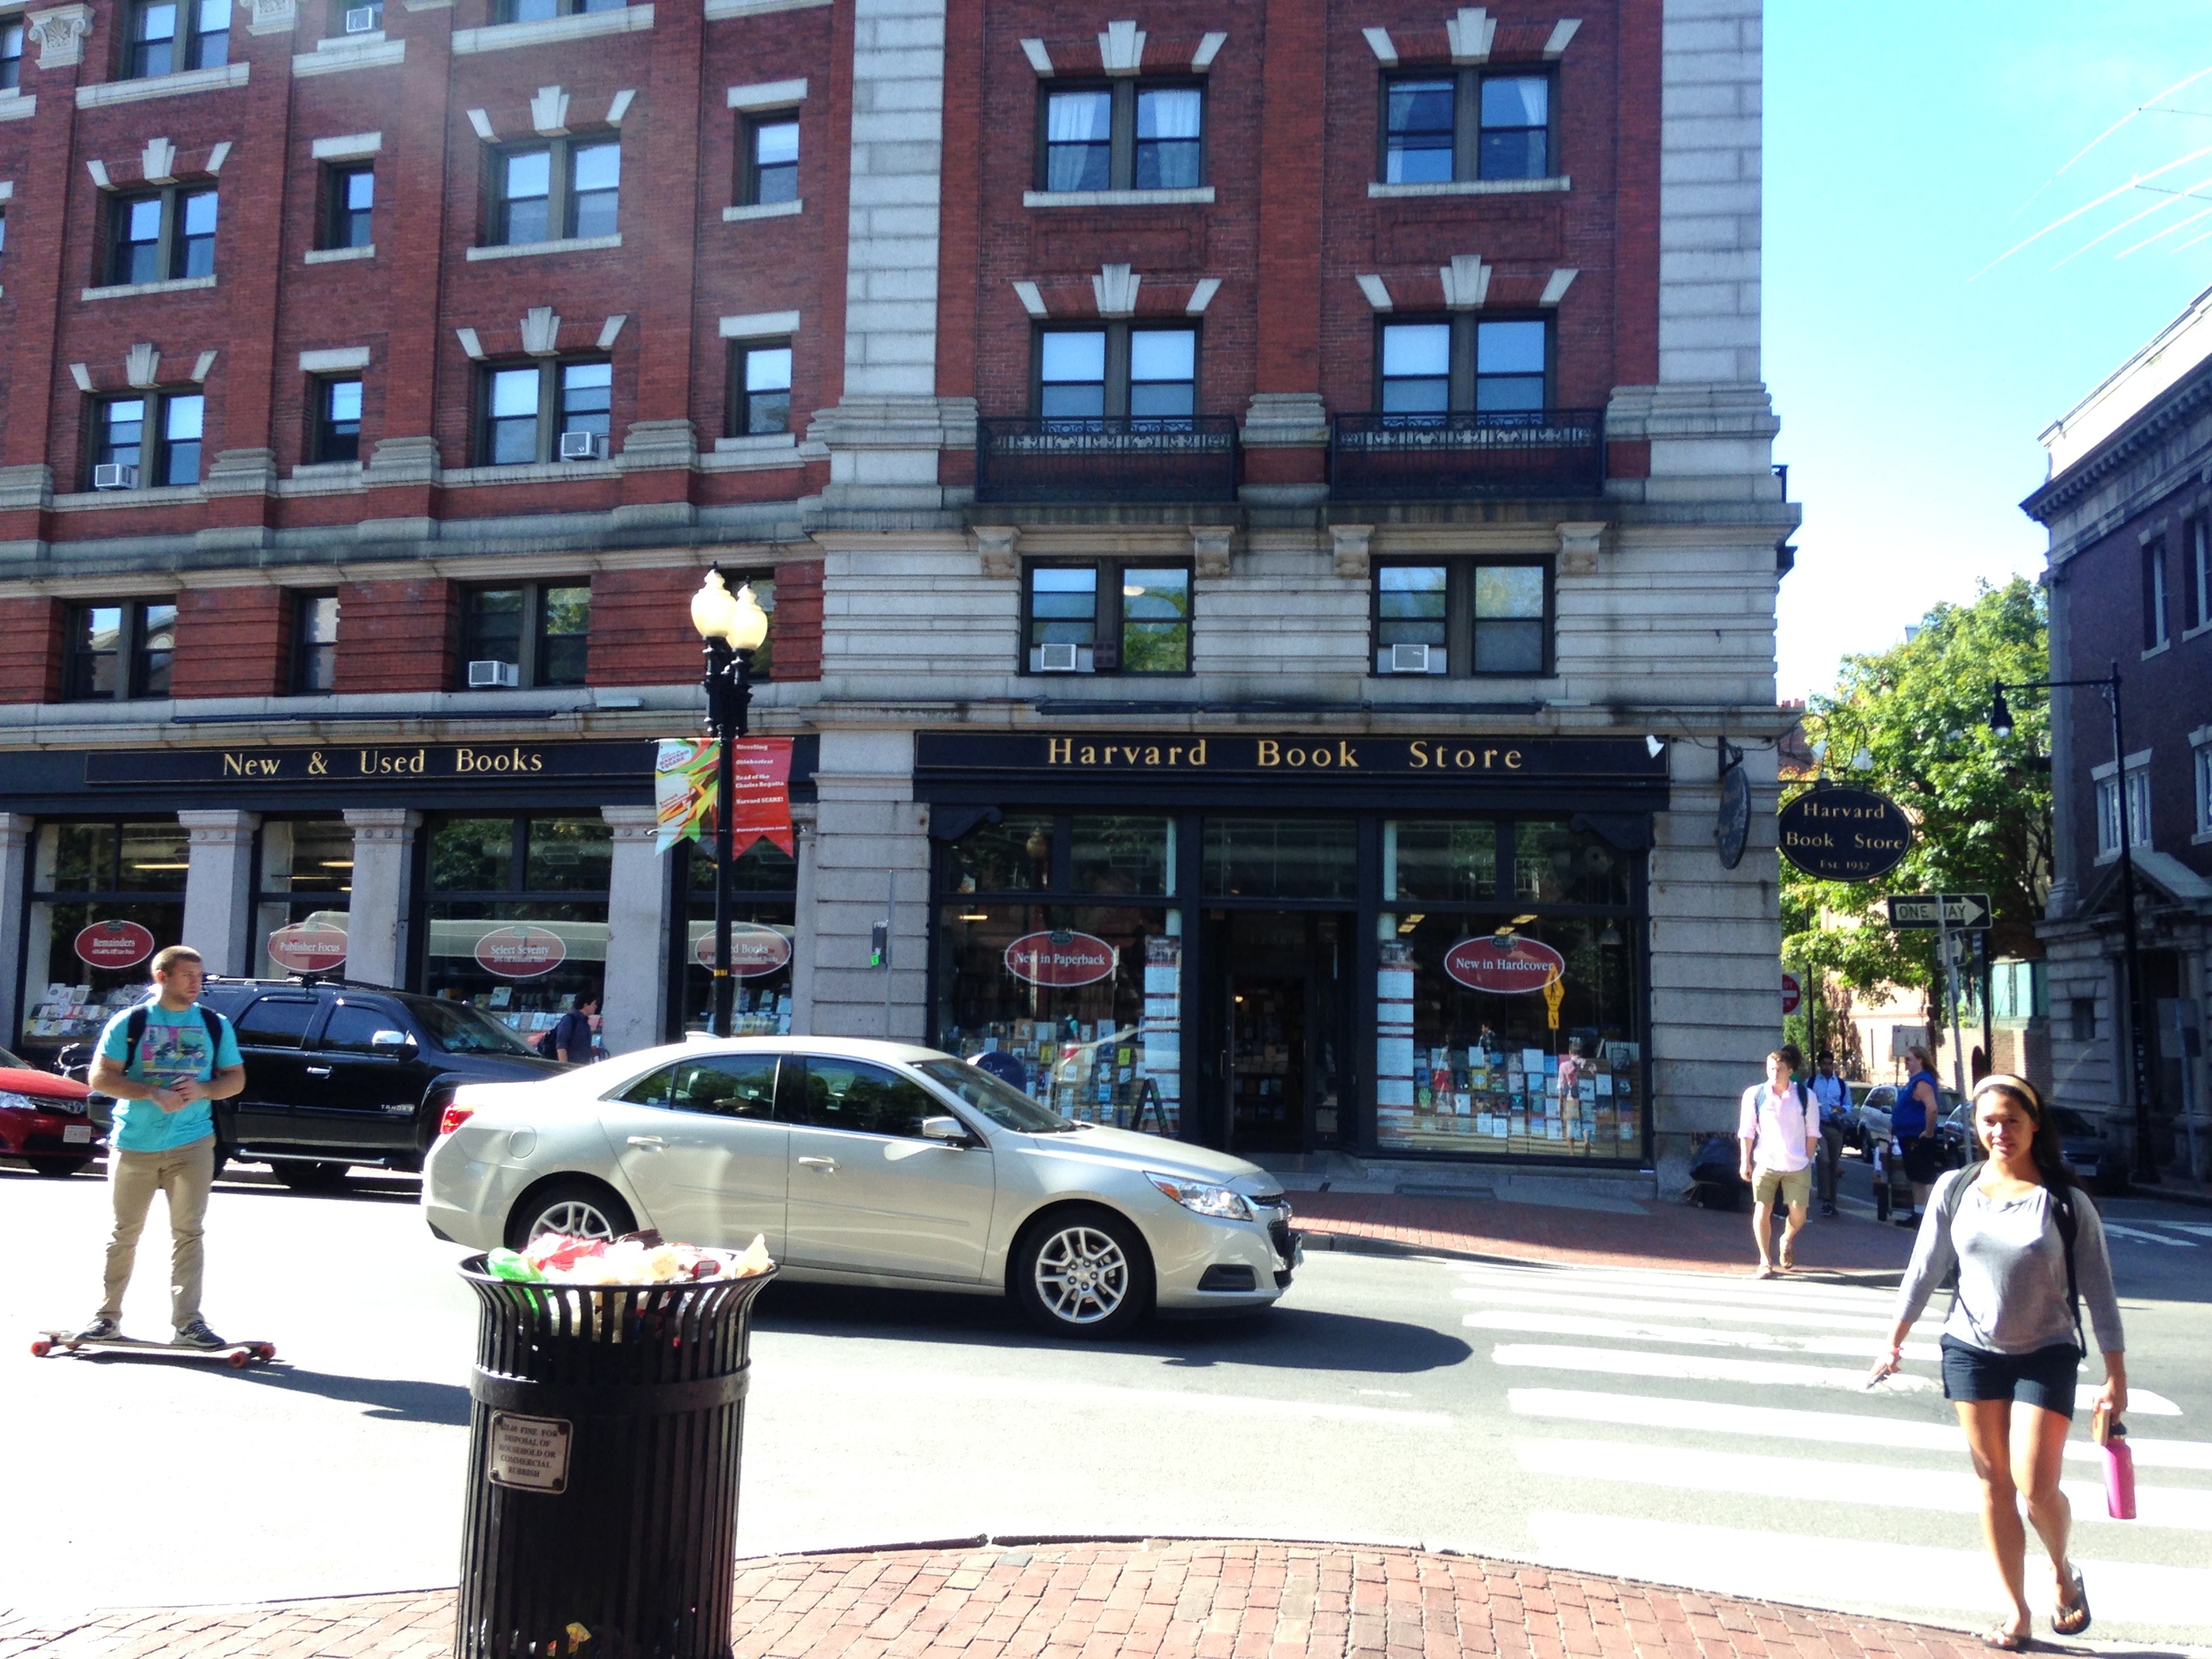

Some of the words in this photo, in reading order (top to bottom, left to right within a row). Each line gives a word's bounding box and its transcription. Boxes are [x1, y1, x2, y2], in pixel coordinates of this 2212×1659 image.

[1048, 738, 1209, 765] Harvard
[1257, 740, 1360, 767] Book
[1409, 740, 1523, 769] Store
[223, 753, 281, 775] New
[307, 750, 329, 774] &
[360, 749, 425, 774] Used
[456, 747, 543, 772] Books
[1803, 802, 1885, 819] Harvard
[1786, 831, 1835, 848] Book
[1854, 833, 1903, 849] Store
[1846, 861, 1870, 871] 1932
[1899, 905, 1929, 918] ONE
[1941, 905, 1966, 918] AY
[280, 941, 317, 951] Publisher
[318, 942, 341, 952] Focus
[490, 944, 515, 954] Select
[518, 944, 550, 956] Seventy
[741, 943, 769, 954] Books
[1016, 952, 1038, 964] New
[1041, 953, 1051, 964] in
[1054, 953, 1105, 967] Paperback
[1455, 957, 1480, 969] New
[1483, 958, 1494, 970] in
[1497, 959, 1555, 972] Hardcover
[504, 1434, 538, 1447] DISPOSAL
[541, 1429, 557, 1438] FOR
[498, 1443, 543, 1457] HOUSEHOLD
[543, 1450, 557, 1459] OR
[500, 1455, 552, 1469] COMMERCIAL
